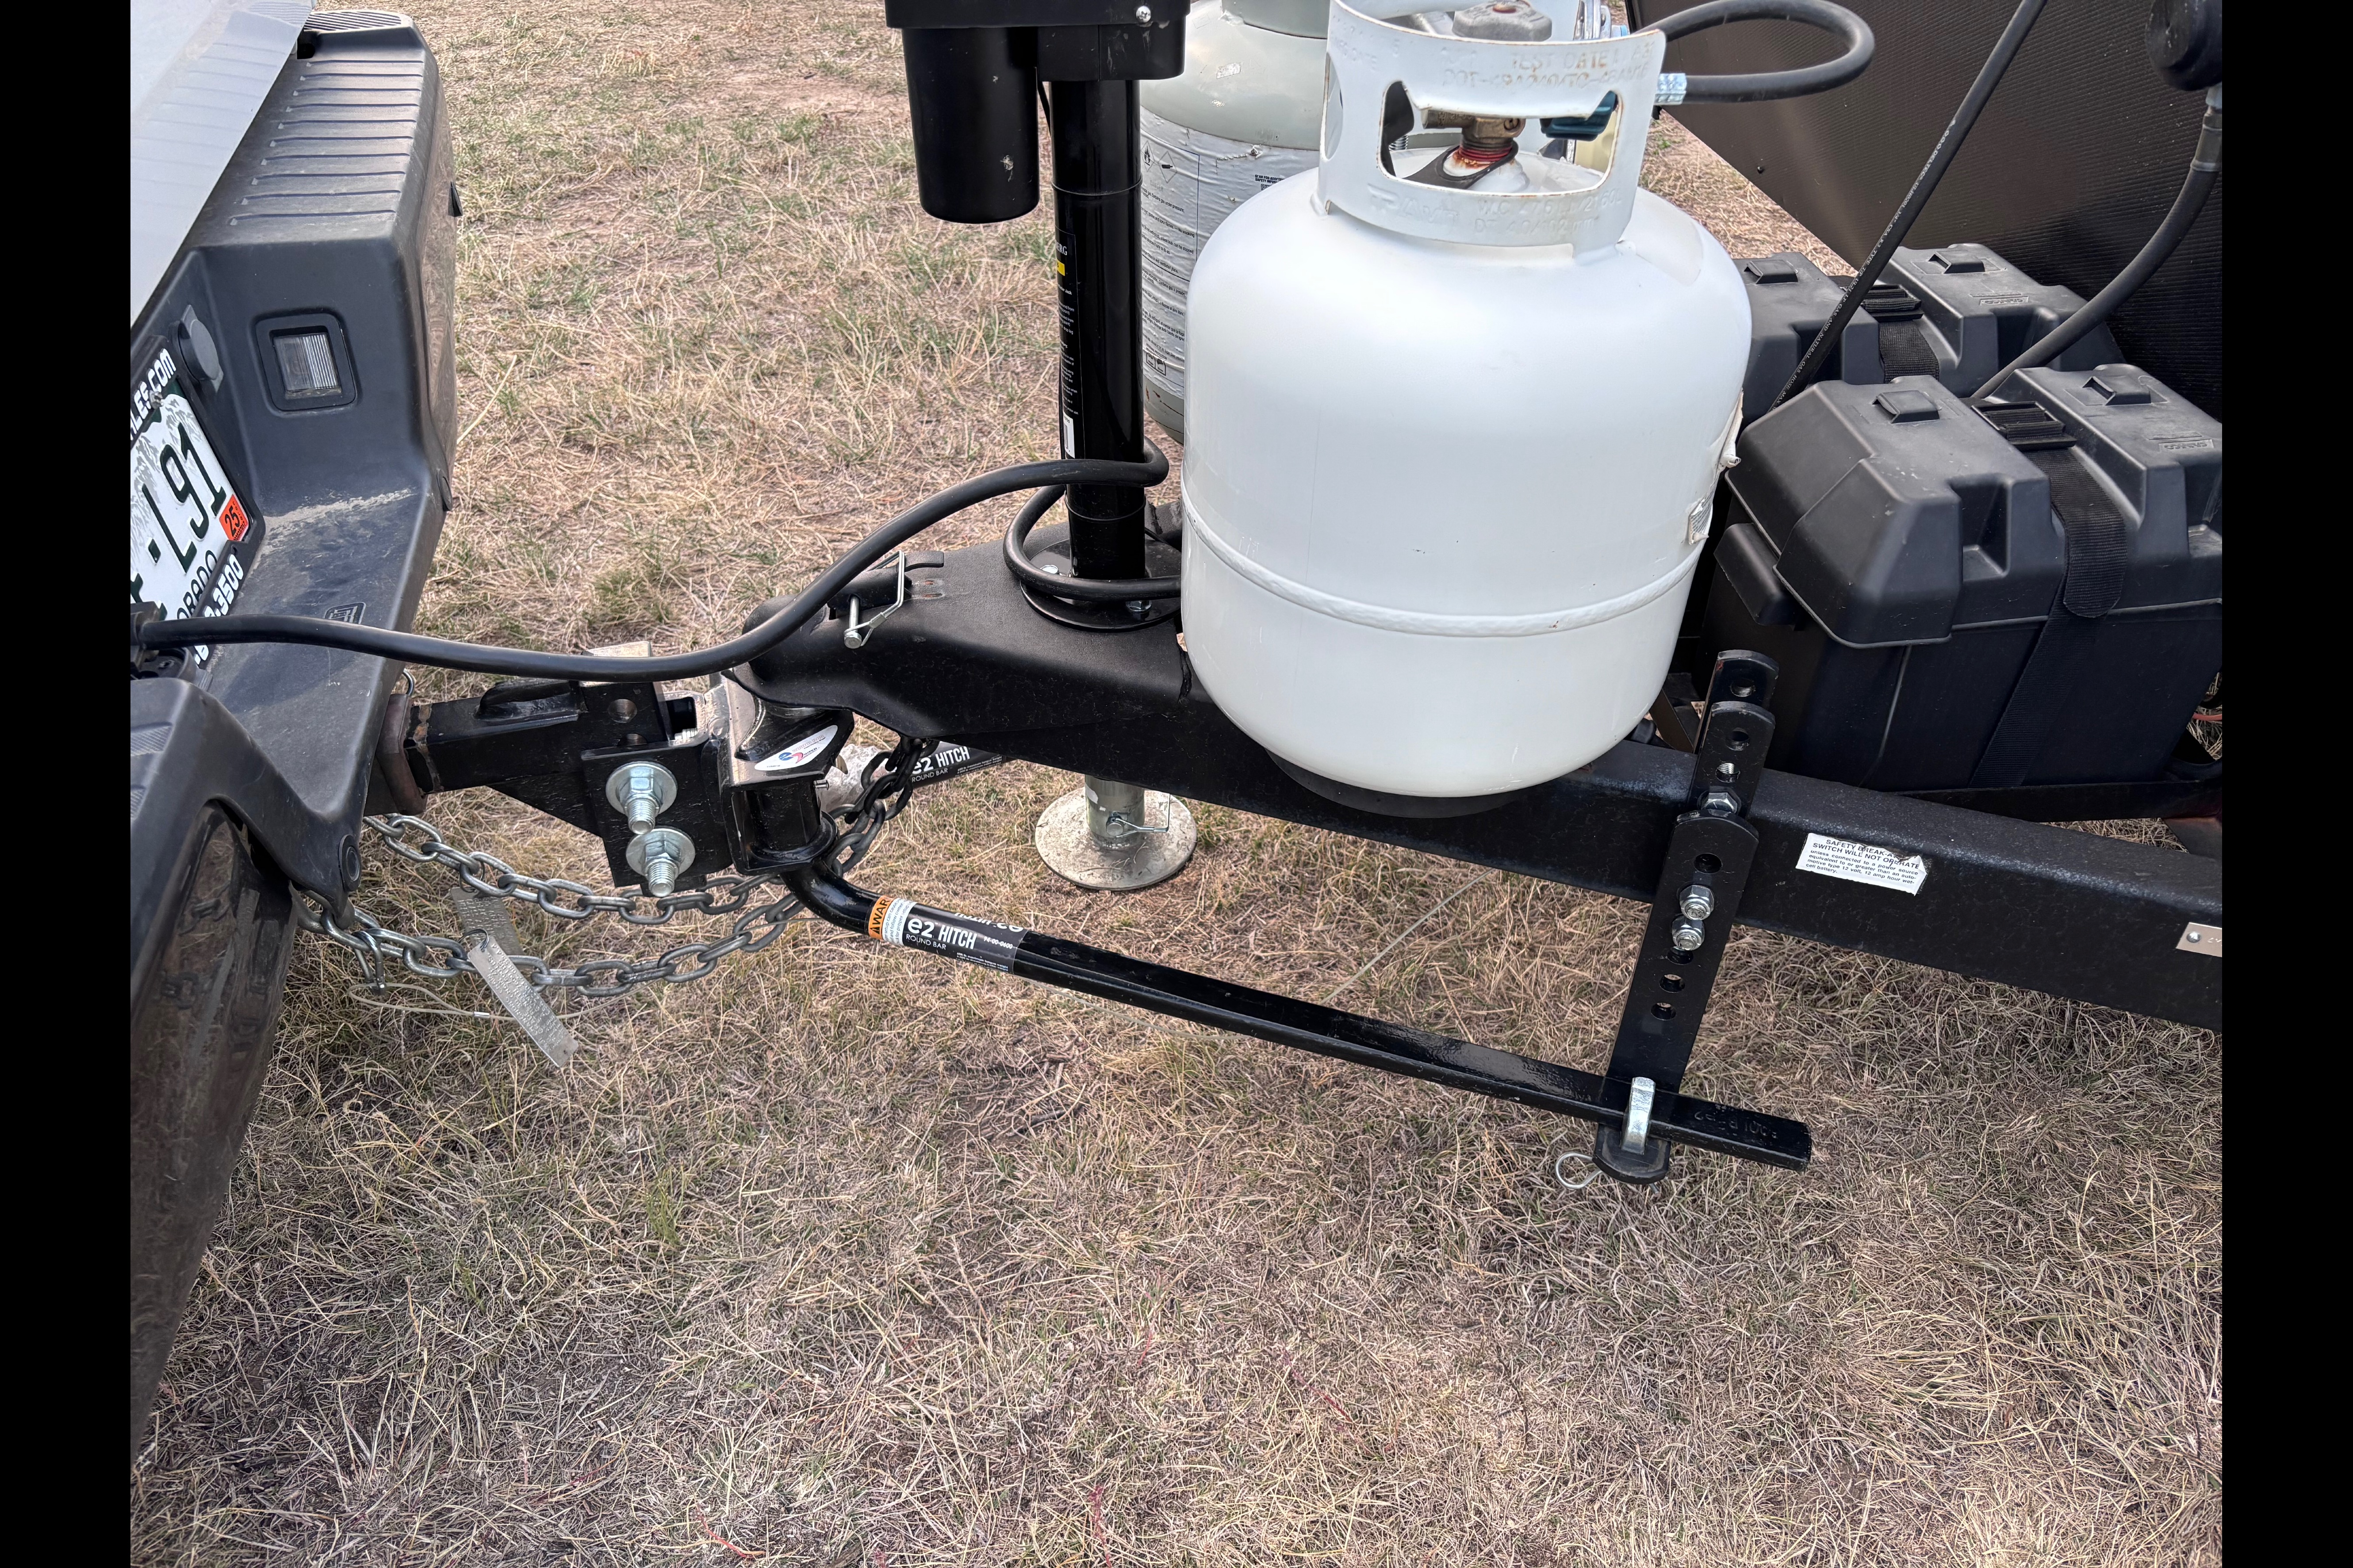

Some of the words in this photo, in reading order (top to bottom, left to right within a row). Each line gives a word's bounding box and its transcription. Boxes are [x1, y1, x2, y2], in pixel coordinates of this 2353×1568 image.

[225, 505, 239, 537] 25
[935, 746, 970, 768] HITCH
[912, 773, 935, 783] ROUND
[1813, 843, 1843, 853] SWITCH
[1826, 840, 1856, 849] SAFETY
[1858, 846, 1897, 857] BREAK-A
[1809, 854, 1838, 864] equivalent
[1832, 854, 1861, 863] connected
[908, 918, 935, 938] e2
[938, 925, 977, 949] HITCH
[906, 934, 931, 945] ROUND
[933, 941, 947, 950] BAR
